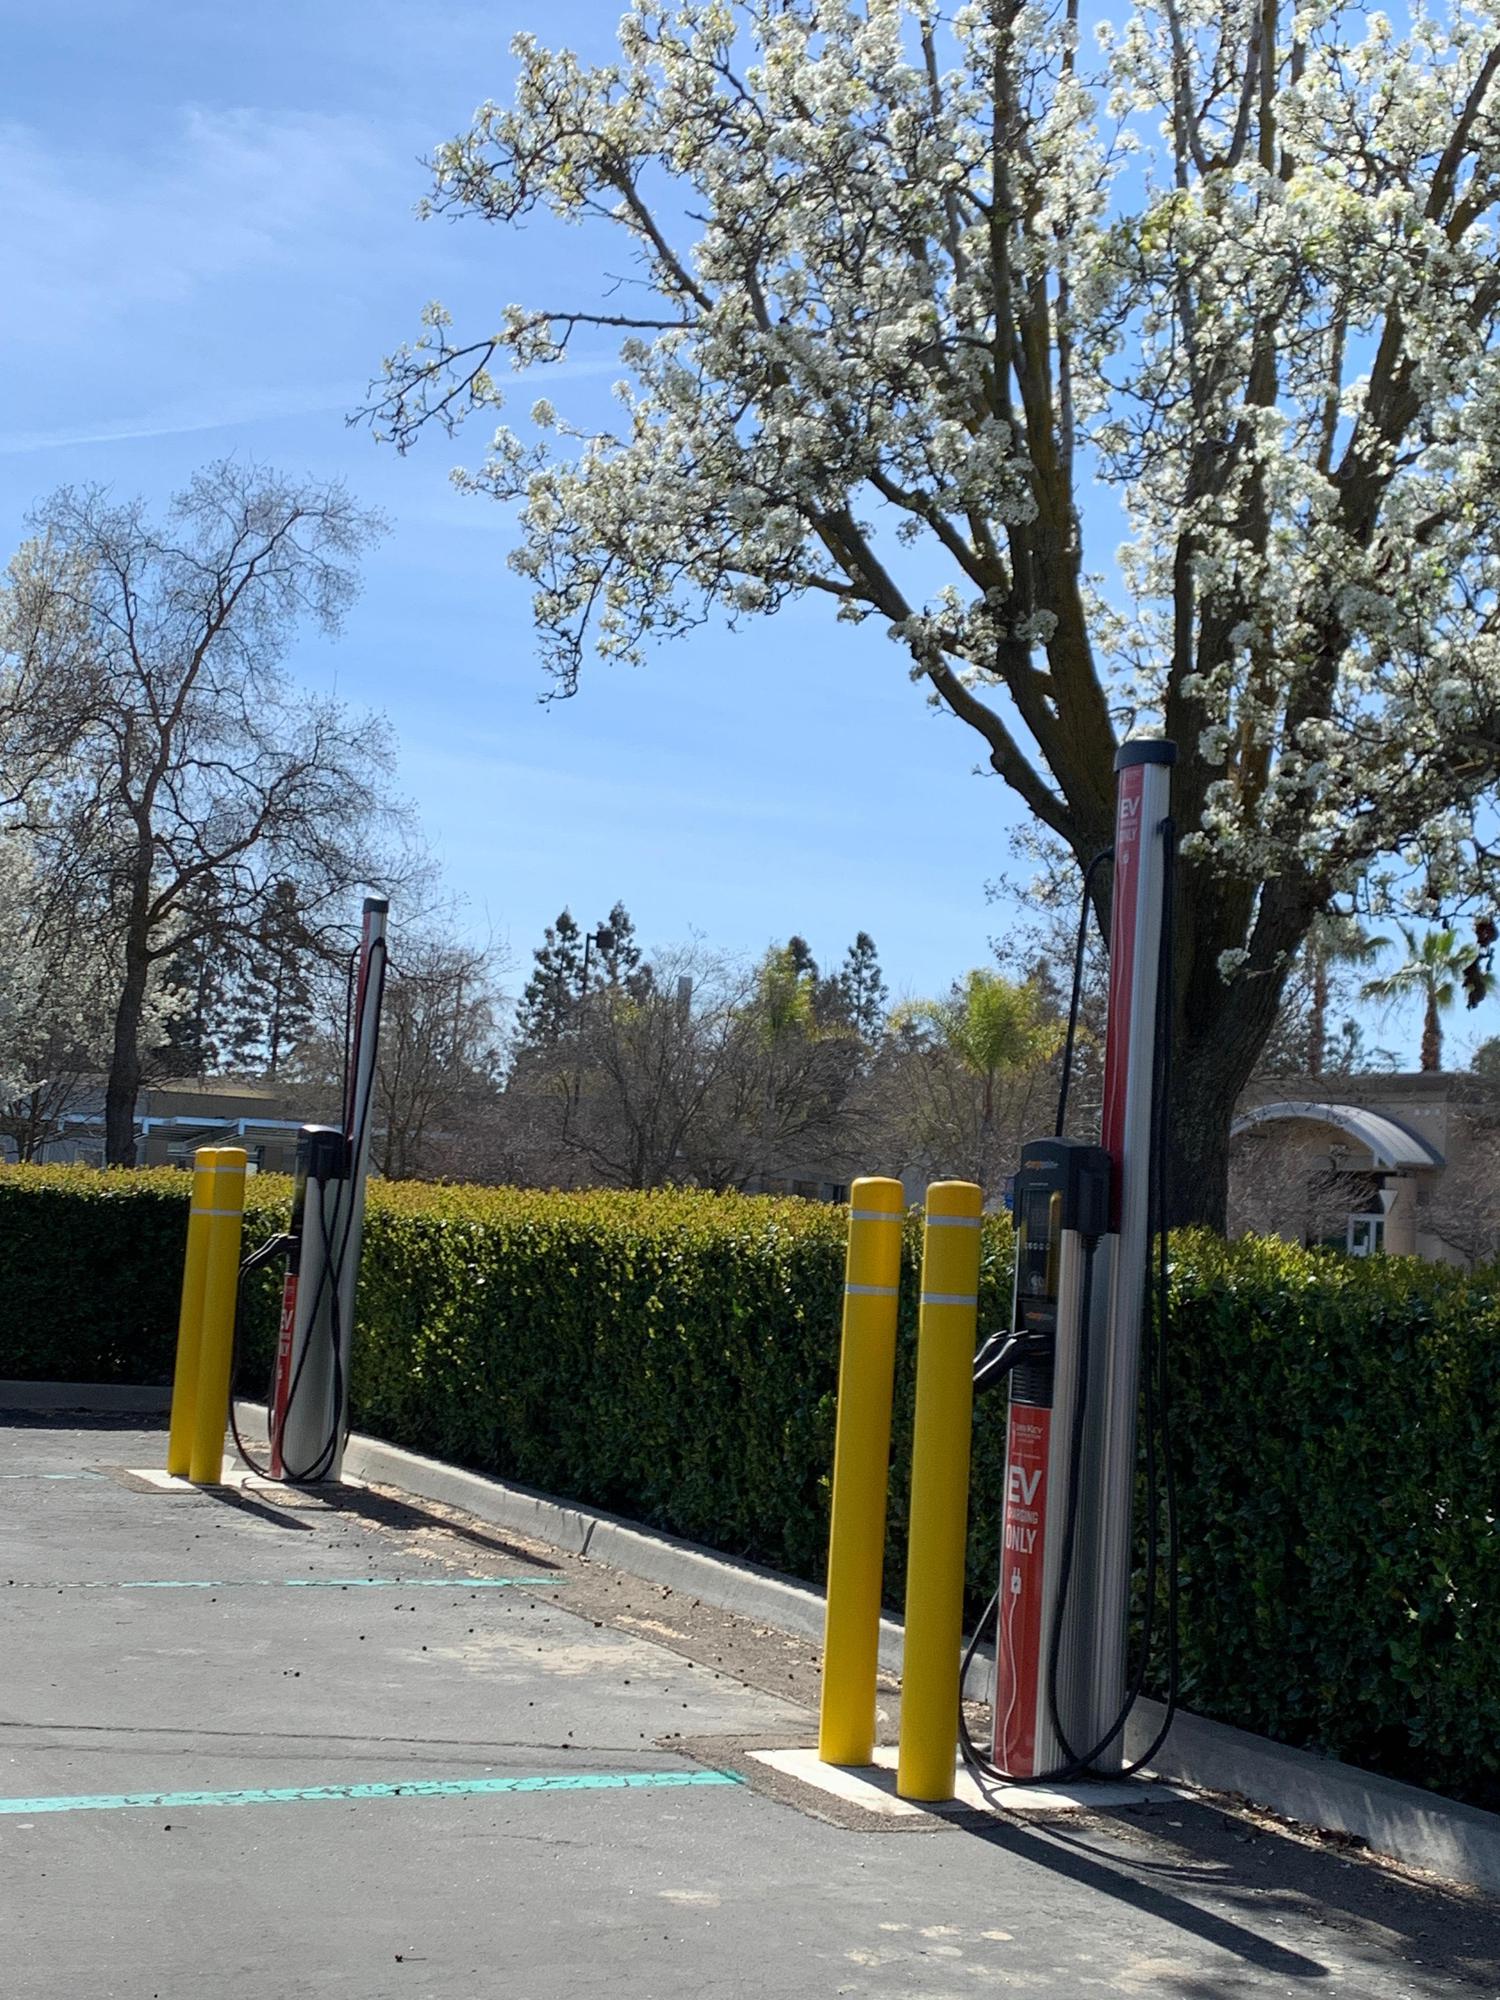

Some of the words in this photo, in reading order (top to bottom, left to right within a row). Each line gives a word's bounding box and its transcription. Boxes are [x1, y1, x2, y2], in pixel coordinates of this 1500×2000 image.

[1121, 796, 1141, 818] EV
[1007, 1465, 1042, 1505] EV
[1006, 1524, 1037, 1554] ONLY
